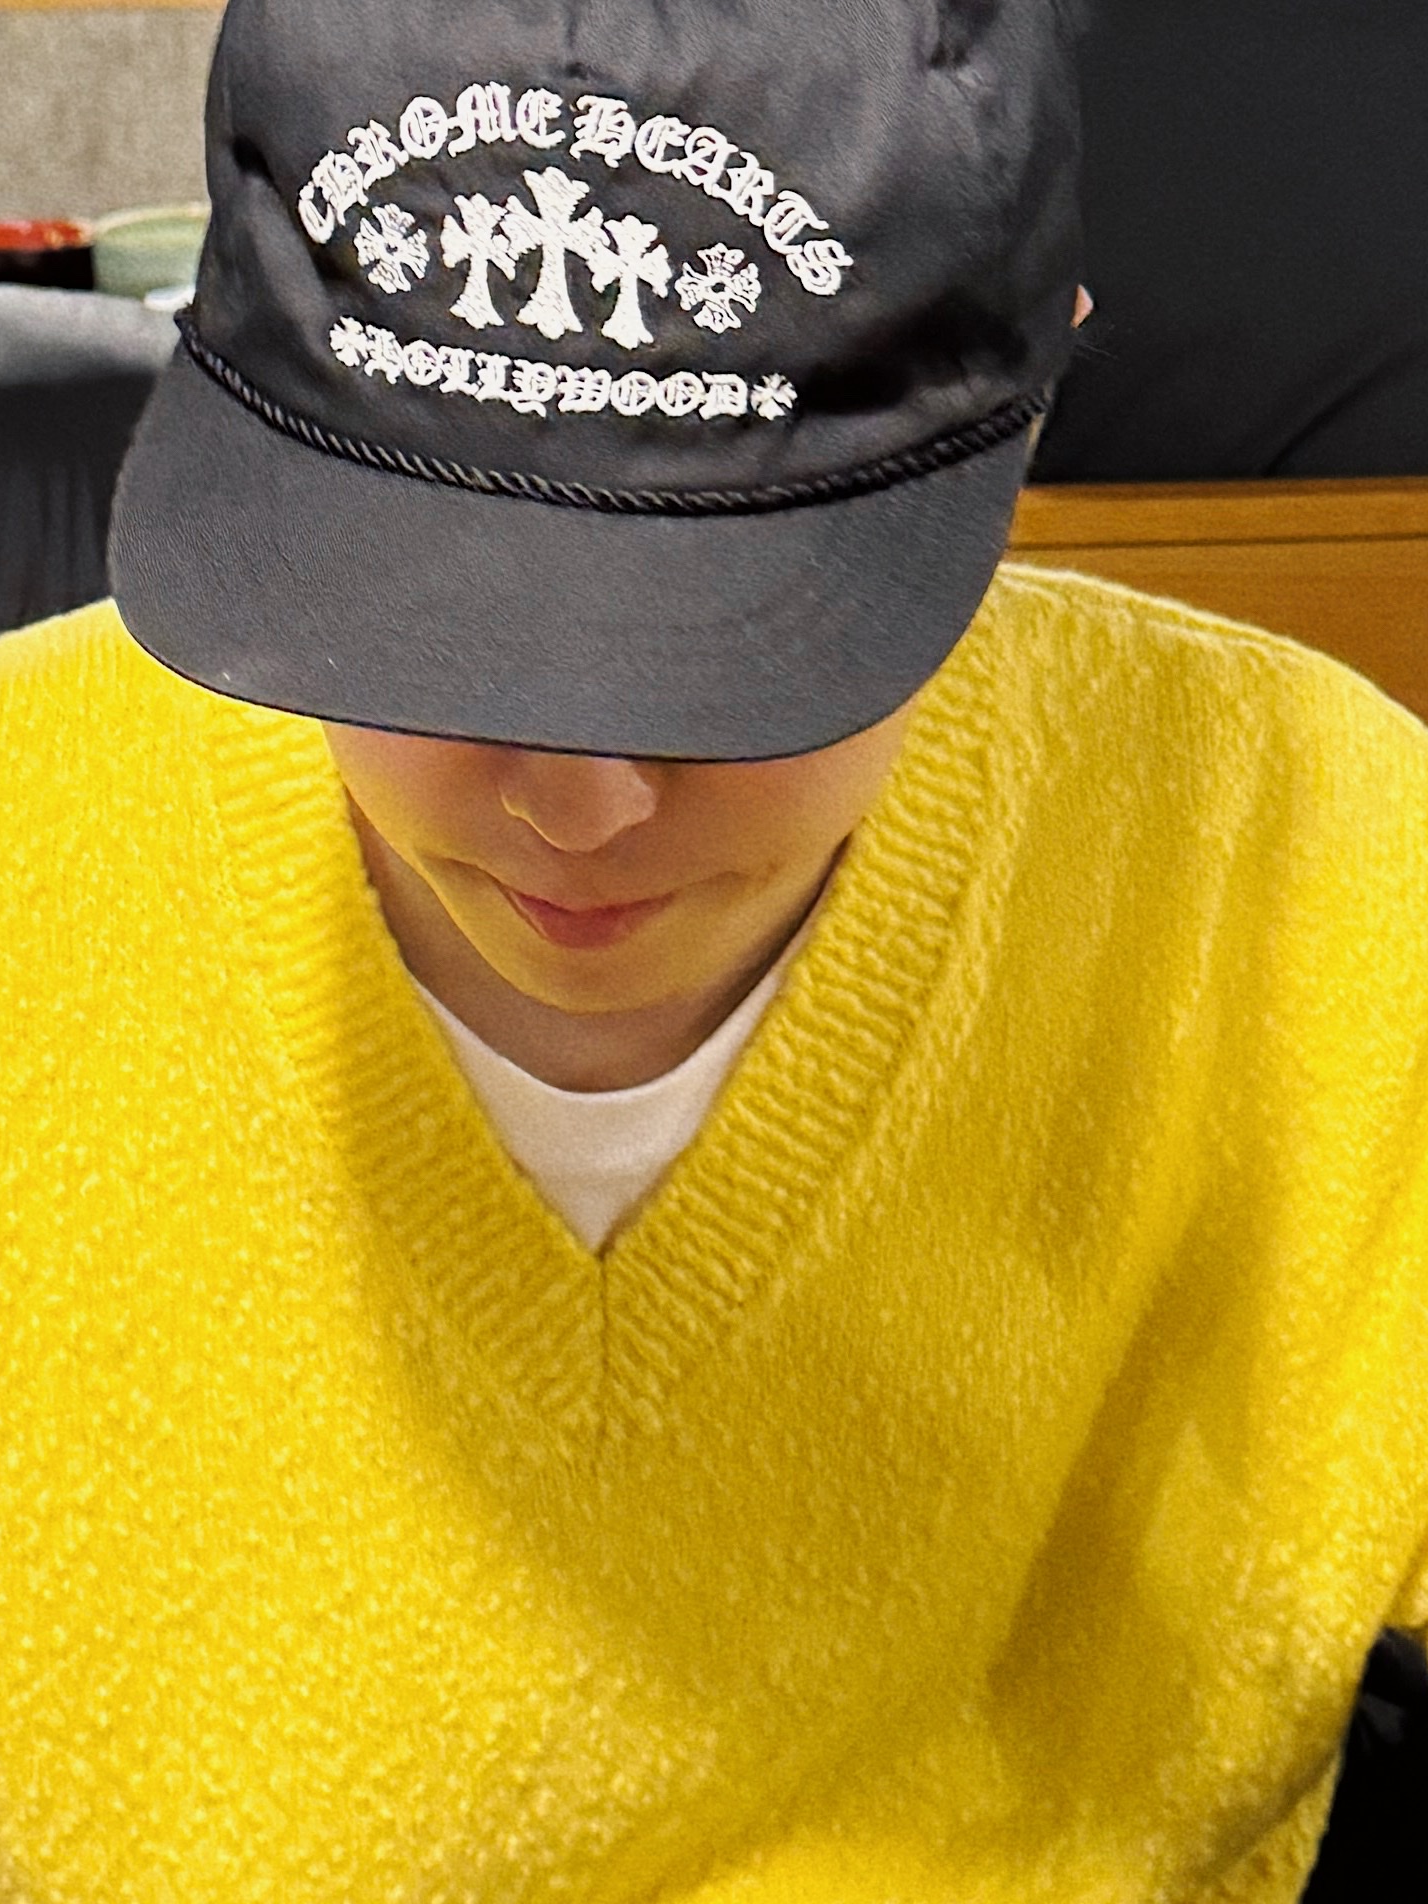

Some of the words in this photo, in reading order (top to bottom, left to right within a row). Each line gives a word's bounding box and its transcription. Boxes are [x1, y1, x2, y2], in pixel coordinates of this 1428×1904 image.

[297, 80, 565, 244] CHROME
[570, 94, 854, 296] HEARTS
[363, 322, 748, 420] HOLLYWOOD
